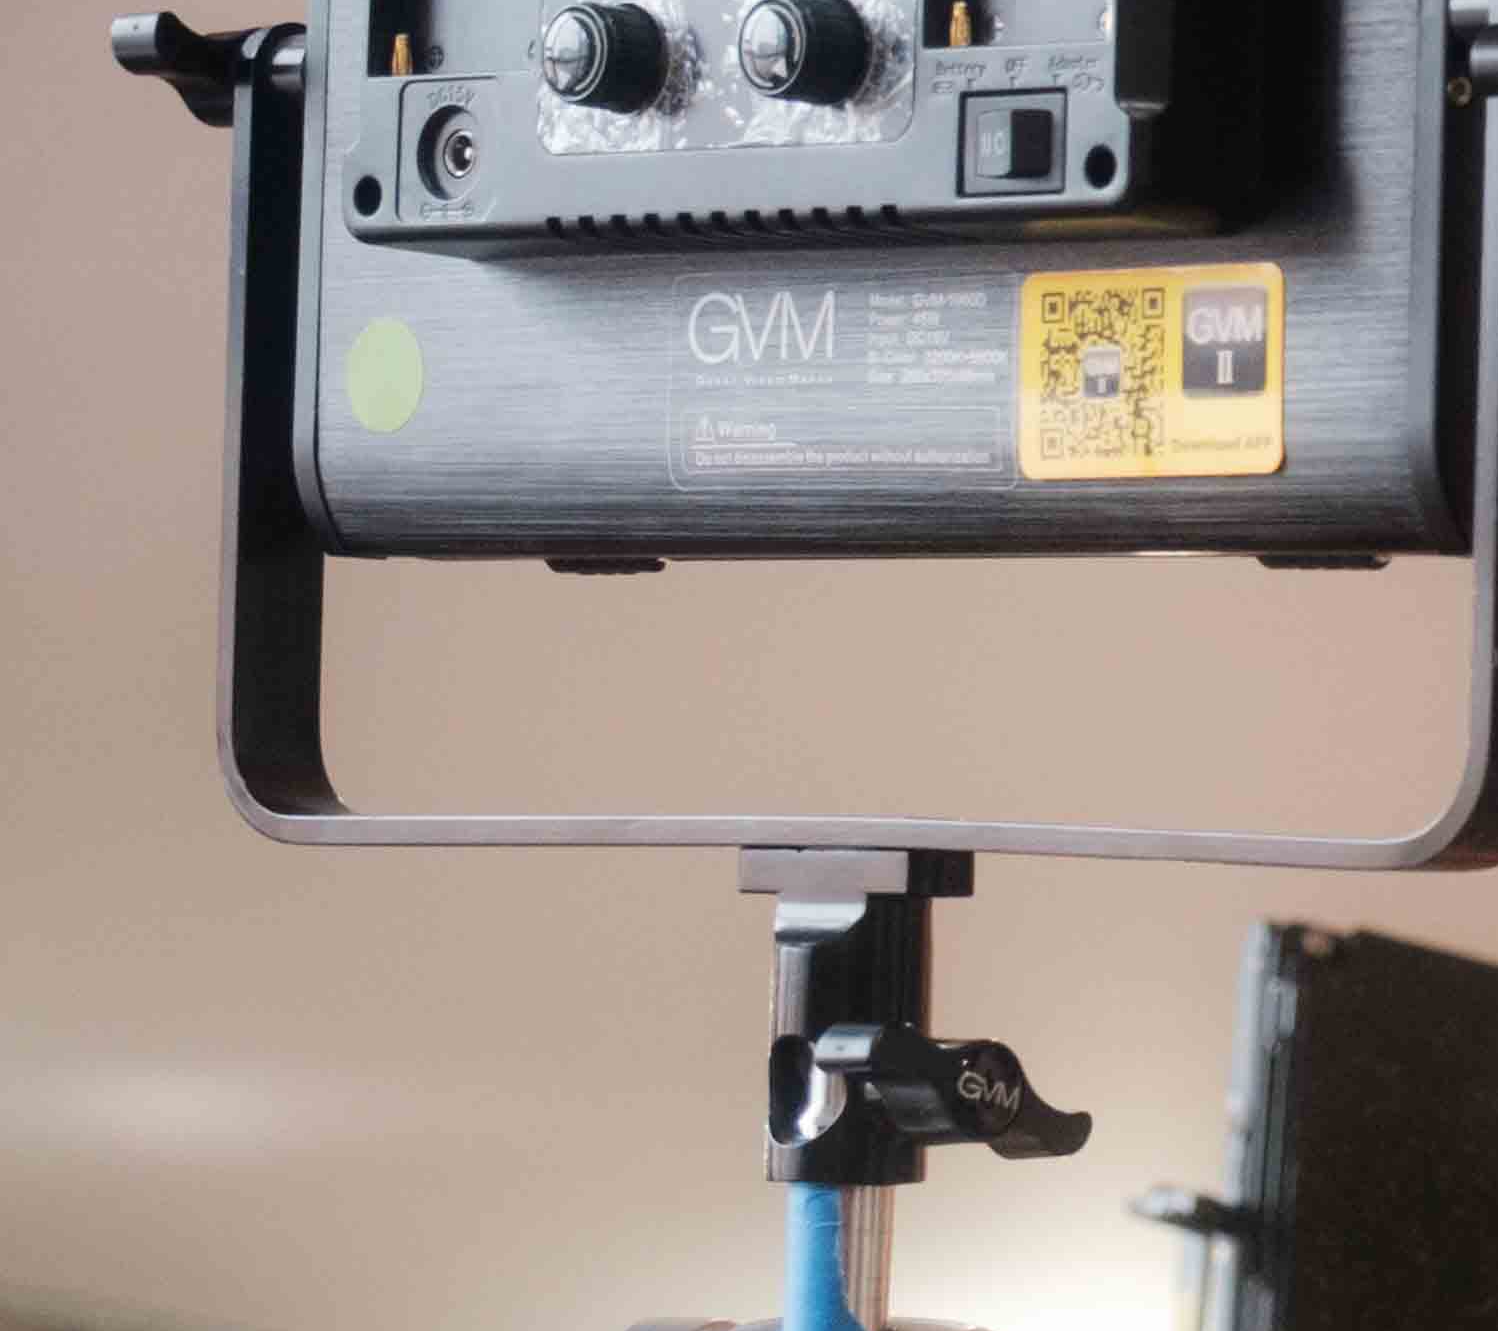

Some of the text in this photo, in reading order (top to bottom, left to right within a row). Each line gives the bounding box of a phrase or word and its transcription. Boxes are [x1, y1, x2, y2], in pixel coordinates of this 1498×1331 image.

[688, 289, 836, 364] GVM
[1186, 304, 1265, 346] GVM
[957, 1070, 1021, 1113] GVM
